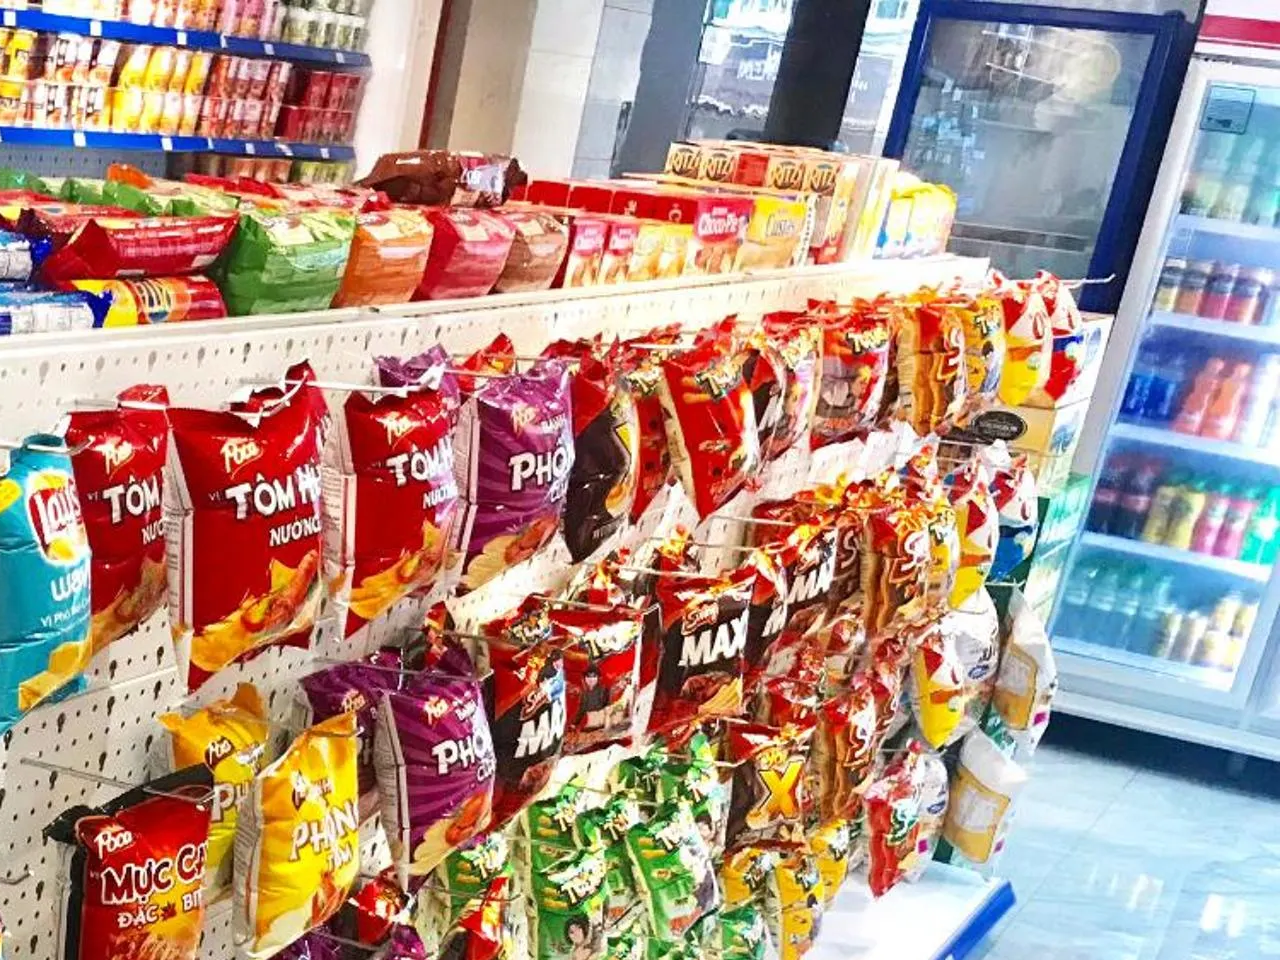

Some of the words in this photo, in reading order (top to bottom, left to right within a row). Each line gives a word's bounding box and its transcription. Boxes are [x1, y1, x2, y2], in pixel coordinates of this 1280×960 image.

[221, 438, 262, 473] Poca
[103, 475, 160, 523] TÔM
[226, 473, 296, 519] TÔM
[678, 608, 750, 667] MAX
[94, 827, 133, 860] Poca
[101, 858, 173, 904] MỰC
